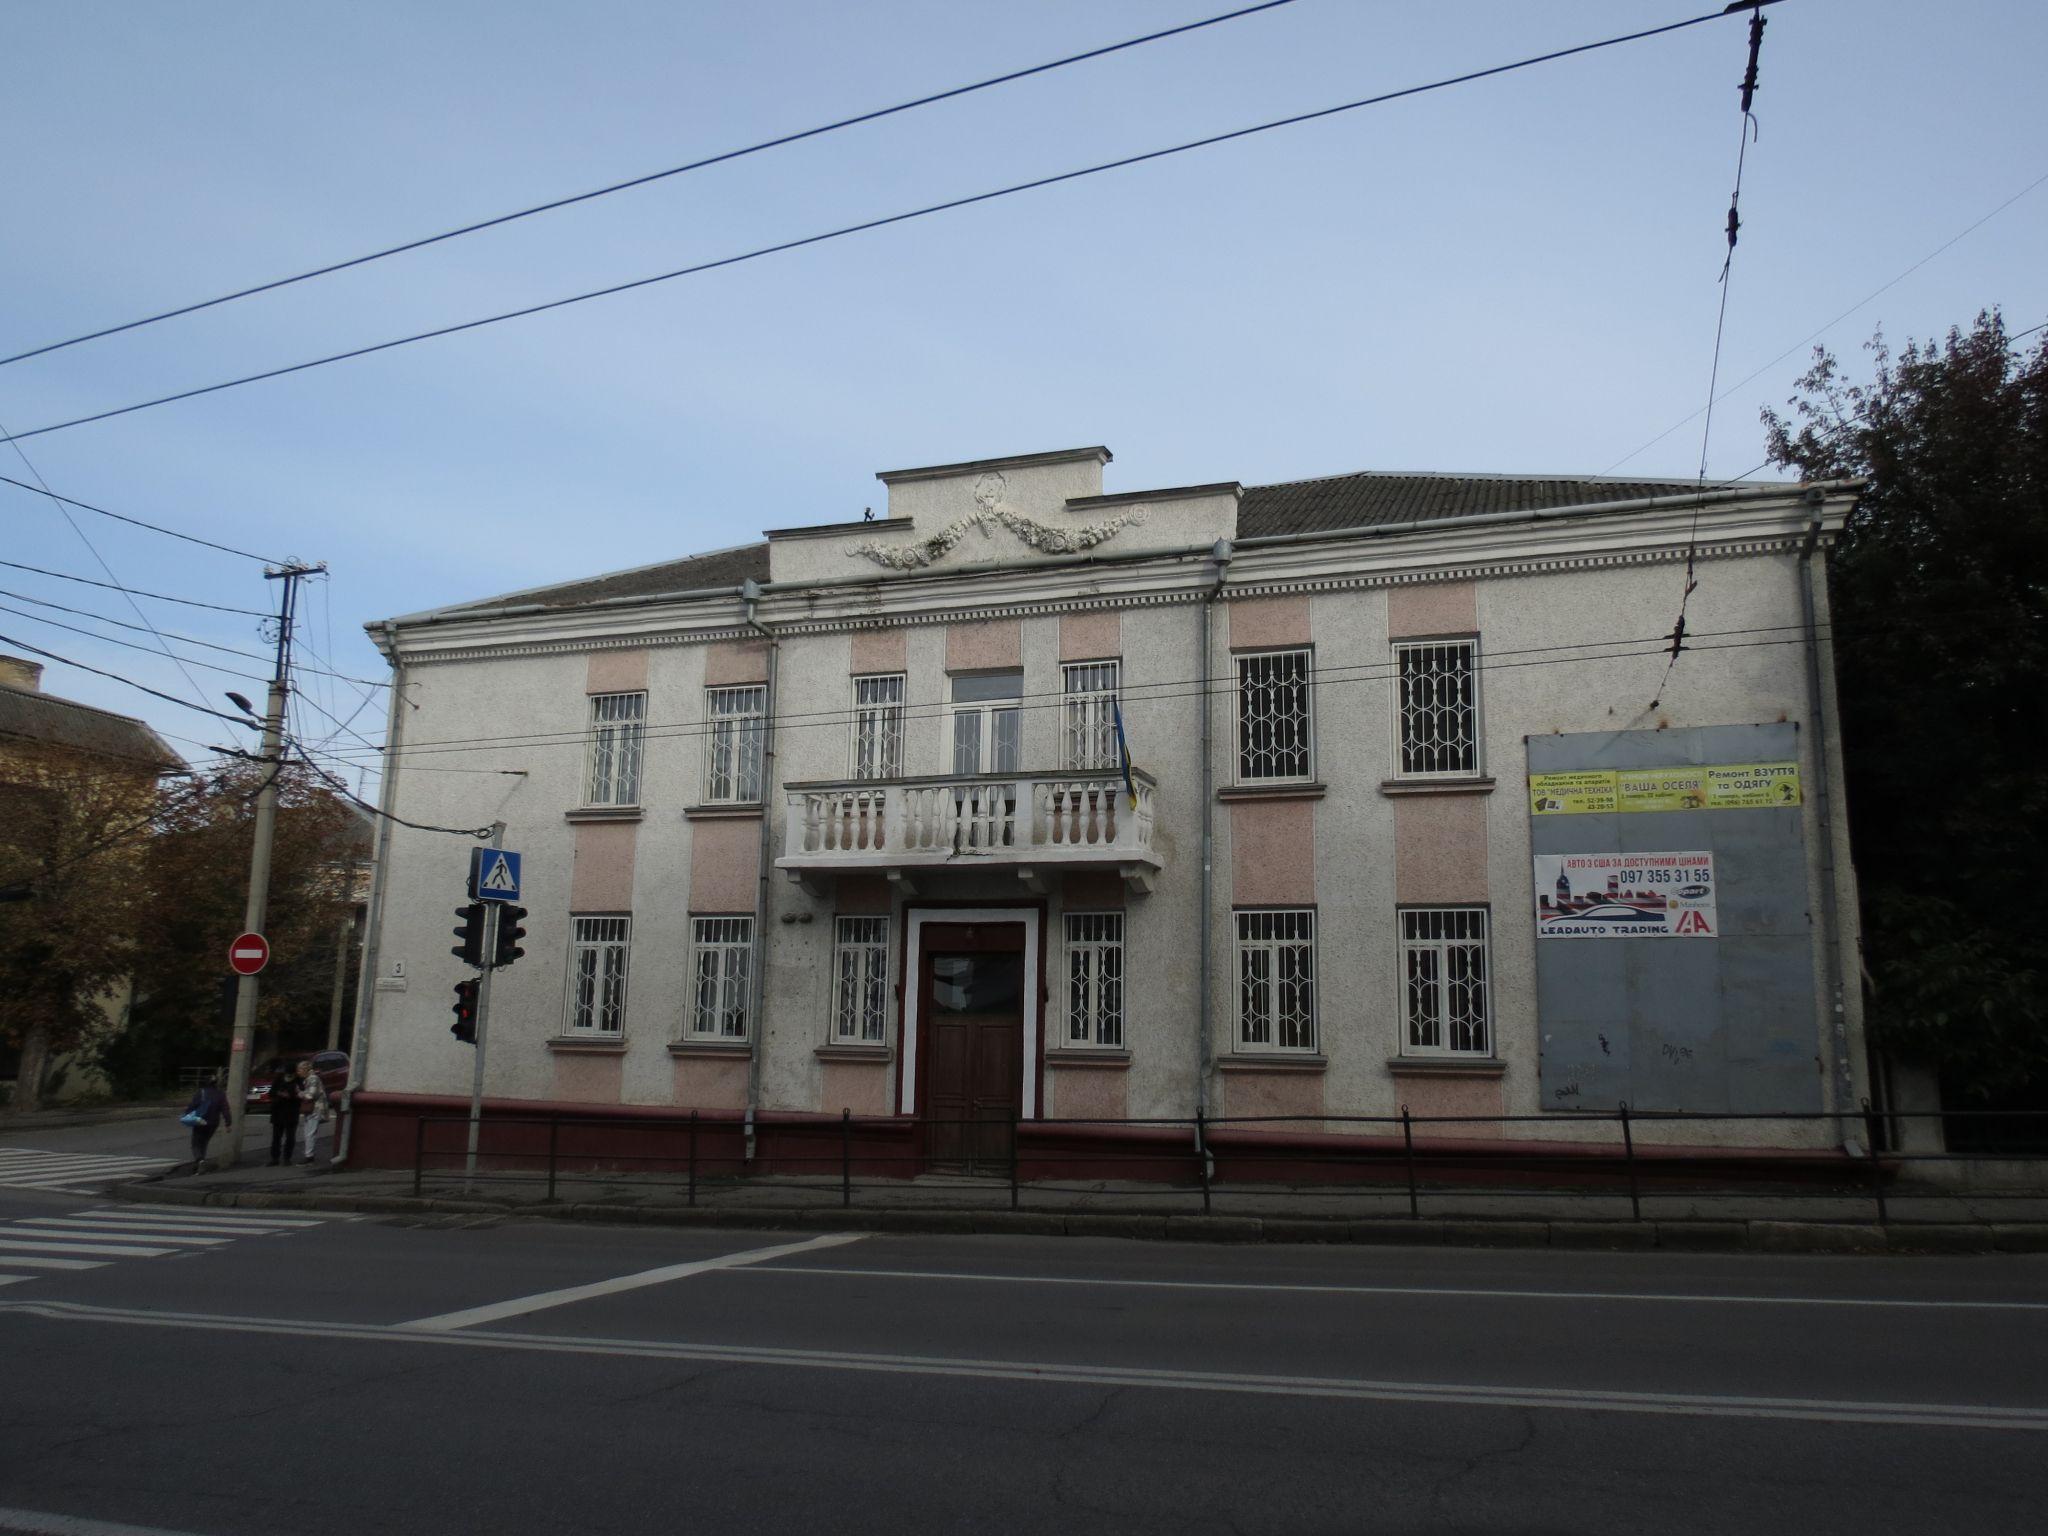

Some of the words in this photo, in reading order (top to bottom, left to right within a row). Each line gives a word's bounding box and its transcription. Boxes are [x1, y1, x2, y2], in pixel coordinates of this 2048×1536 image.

[1708, 770, 1750, 779] Ремонт
[1754, 767, 1795, 777] ВЗУТТЯ
[1619, 782, 1658, 792] "ВАША
[1662, 780, 1704, 791] ОСЕЛЯ"
[1733, 780, 1772, 790] ОДЯГУ
[1567, 859, 1586, 868] АВТО
[1594, 859, 1611, 868] США
[1612, 859, 1621, 868] ЗА
[1624, 858, 1677, 868] ДОСТУПНИМИ
[1679, 857, 1709, 867] ЦІНАМИ
[1620, 870, 1643, 883] 097
[1647, 869, 1671, 883] 355
[1674, 869, 1689, 882] 31
[1694, 869, 1710, 882] 55
[1540, 926, 1607, 935] LEADAUTO
[1612, 926, 1669, 934] TRADING
